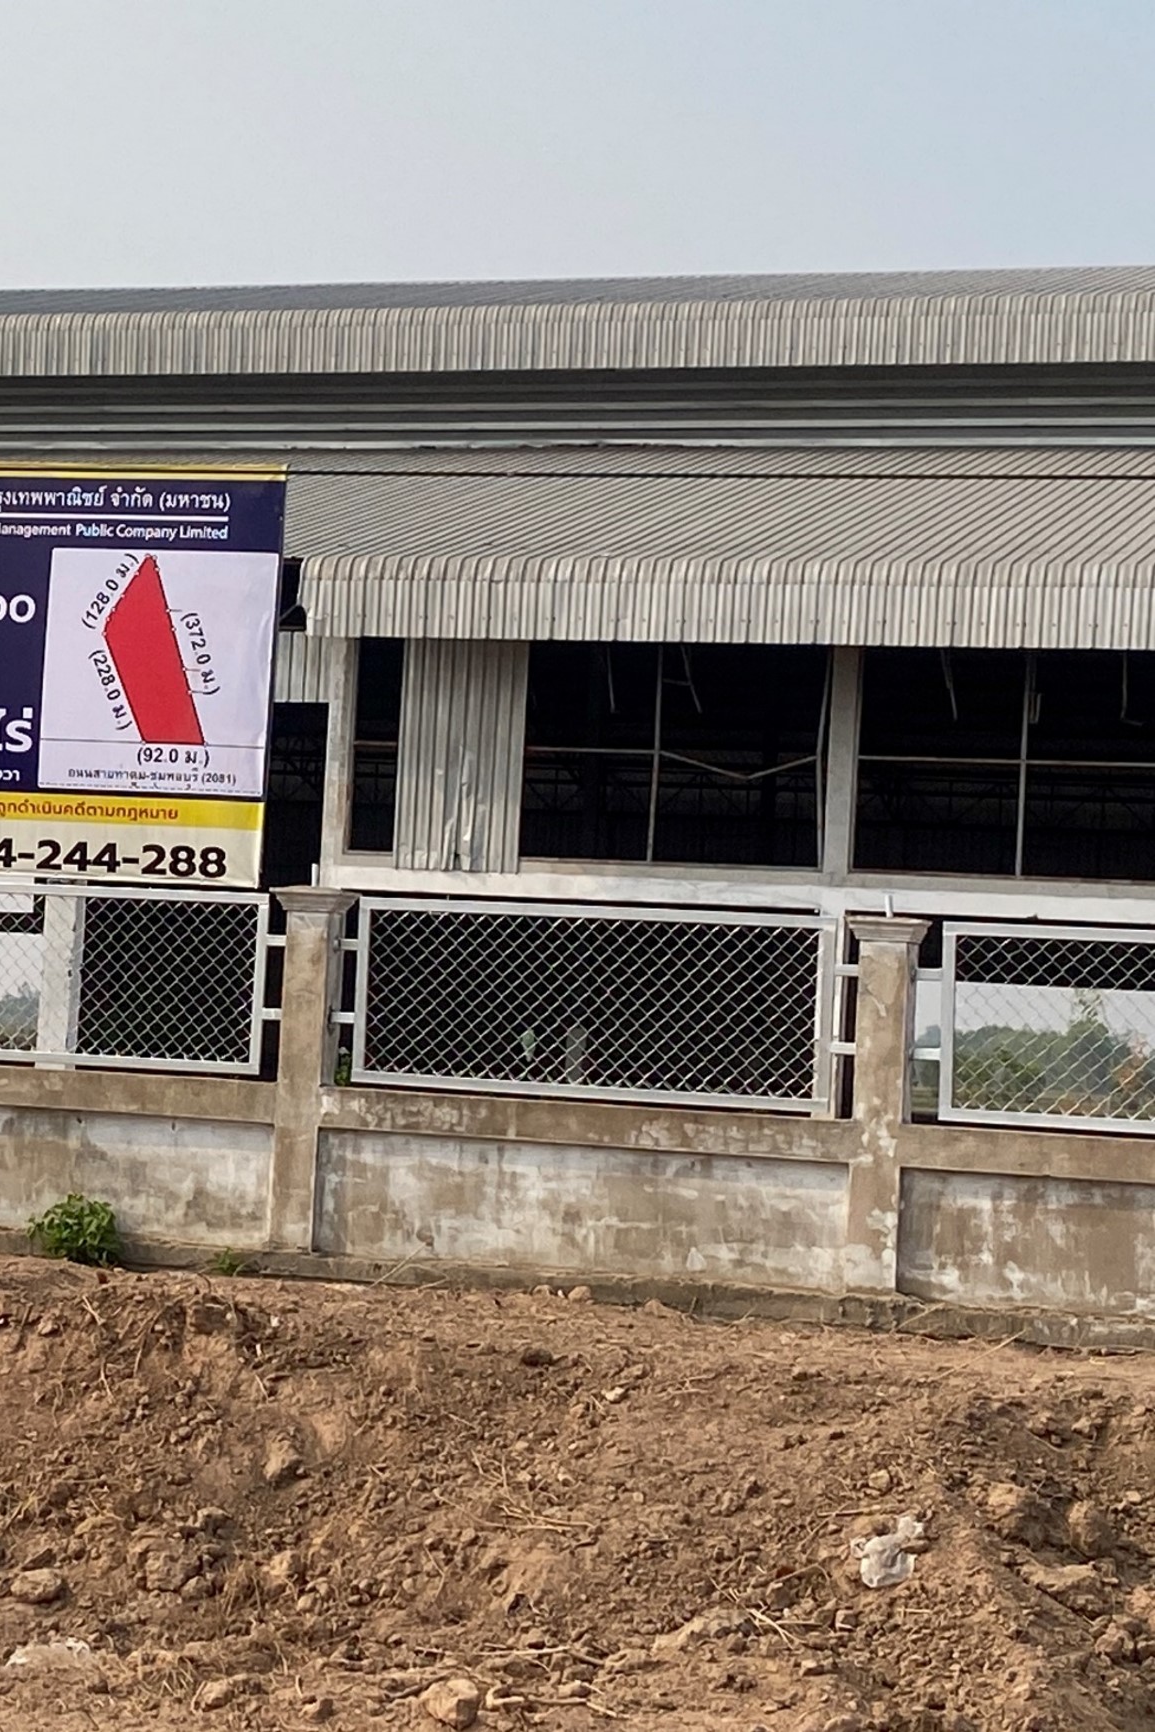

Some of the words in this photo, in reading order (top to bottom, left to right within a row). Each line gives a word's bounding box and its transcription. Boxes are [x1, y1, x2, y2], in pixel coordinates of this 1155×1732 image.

[110, 487, 153, 508] จำกัด
[159, 492, 231, 511] (มหาชน)
[75, 523, 114, 538] Public
[116, 526, 177, 541] Company
[179, 525, 229, 540] Limited
[81, 578, 119, 629] (128.0
[180, 612, 212, 666] (372.0
[88, 649, 121, 700] (228.0
[137, 748, 179, 766] (92.0
